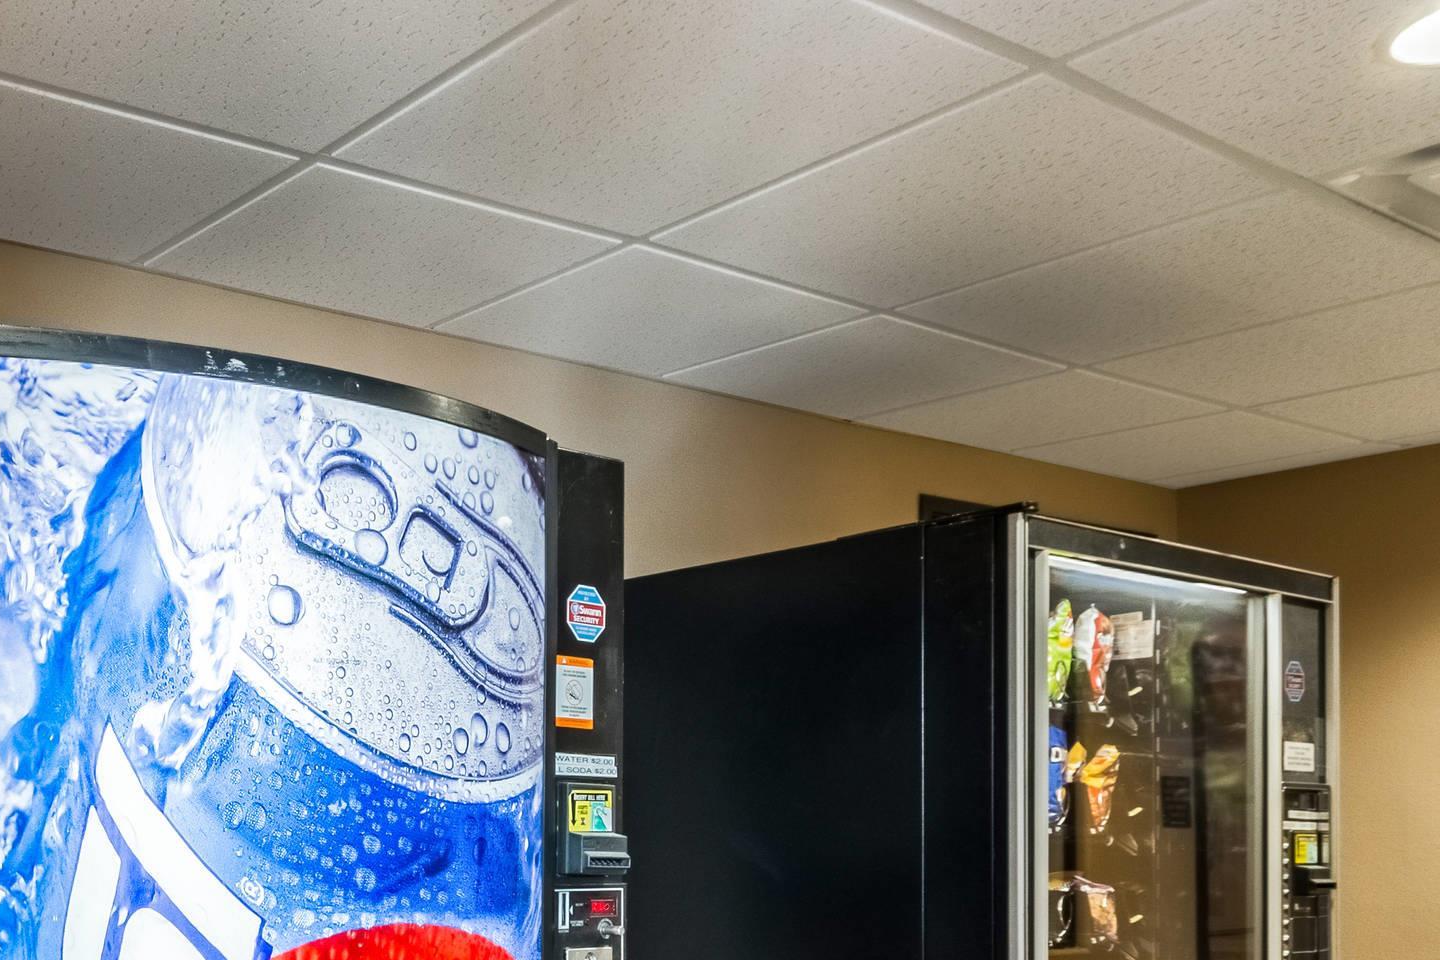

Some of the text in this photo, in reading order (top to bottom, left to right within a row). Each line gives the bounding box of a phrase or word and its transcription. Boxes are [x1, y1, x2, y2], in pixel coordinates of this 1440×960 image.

[579, 604, 602, 617] Swann
[573, 614, 600, 625] SECURITY
[555, 755, 613, 765] WATER $2.00
[566, 766, 592, 774] SODA
